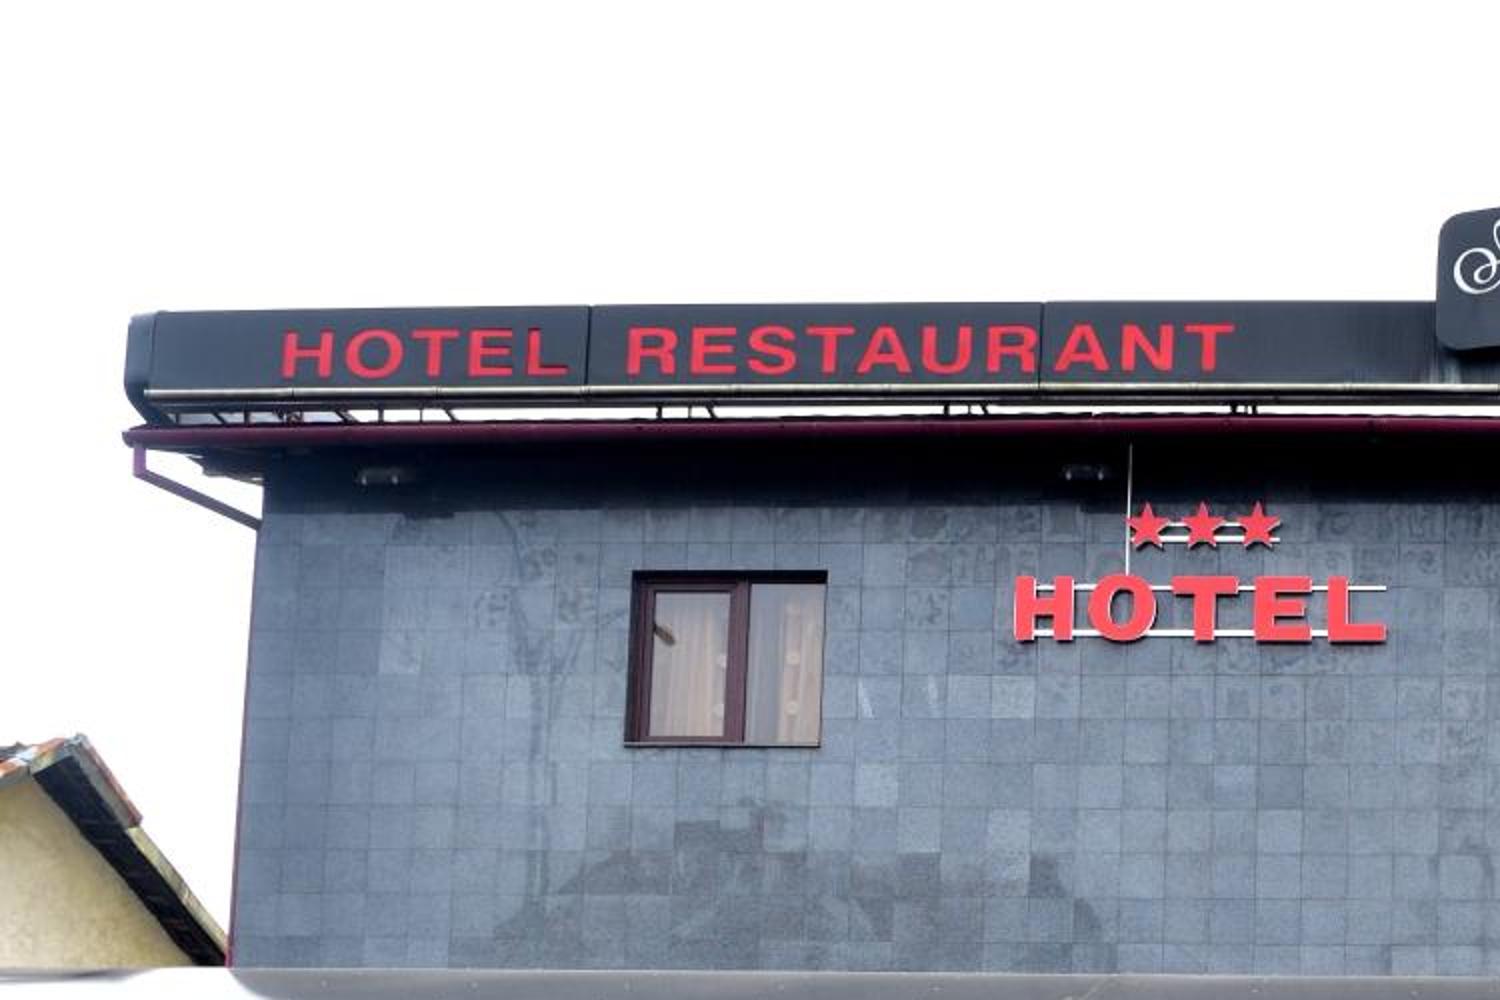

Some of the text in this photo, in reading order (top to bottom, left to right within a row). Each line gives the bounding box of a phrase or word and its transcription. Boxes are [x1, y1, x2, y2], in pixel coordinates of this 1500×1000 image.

[280, 322, 1235, 379] HOTEL RESTAURANT
[1014, 574, 1388, 643] HOTEL
